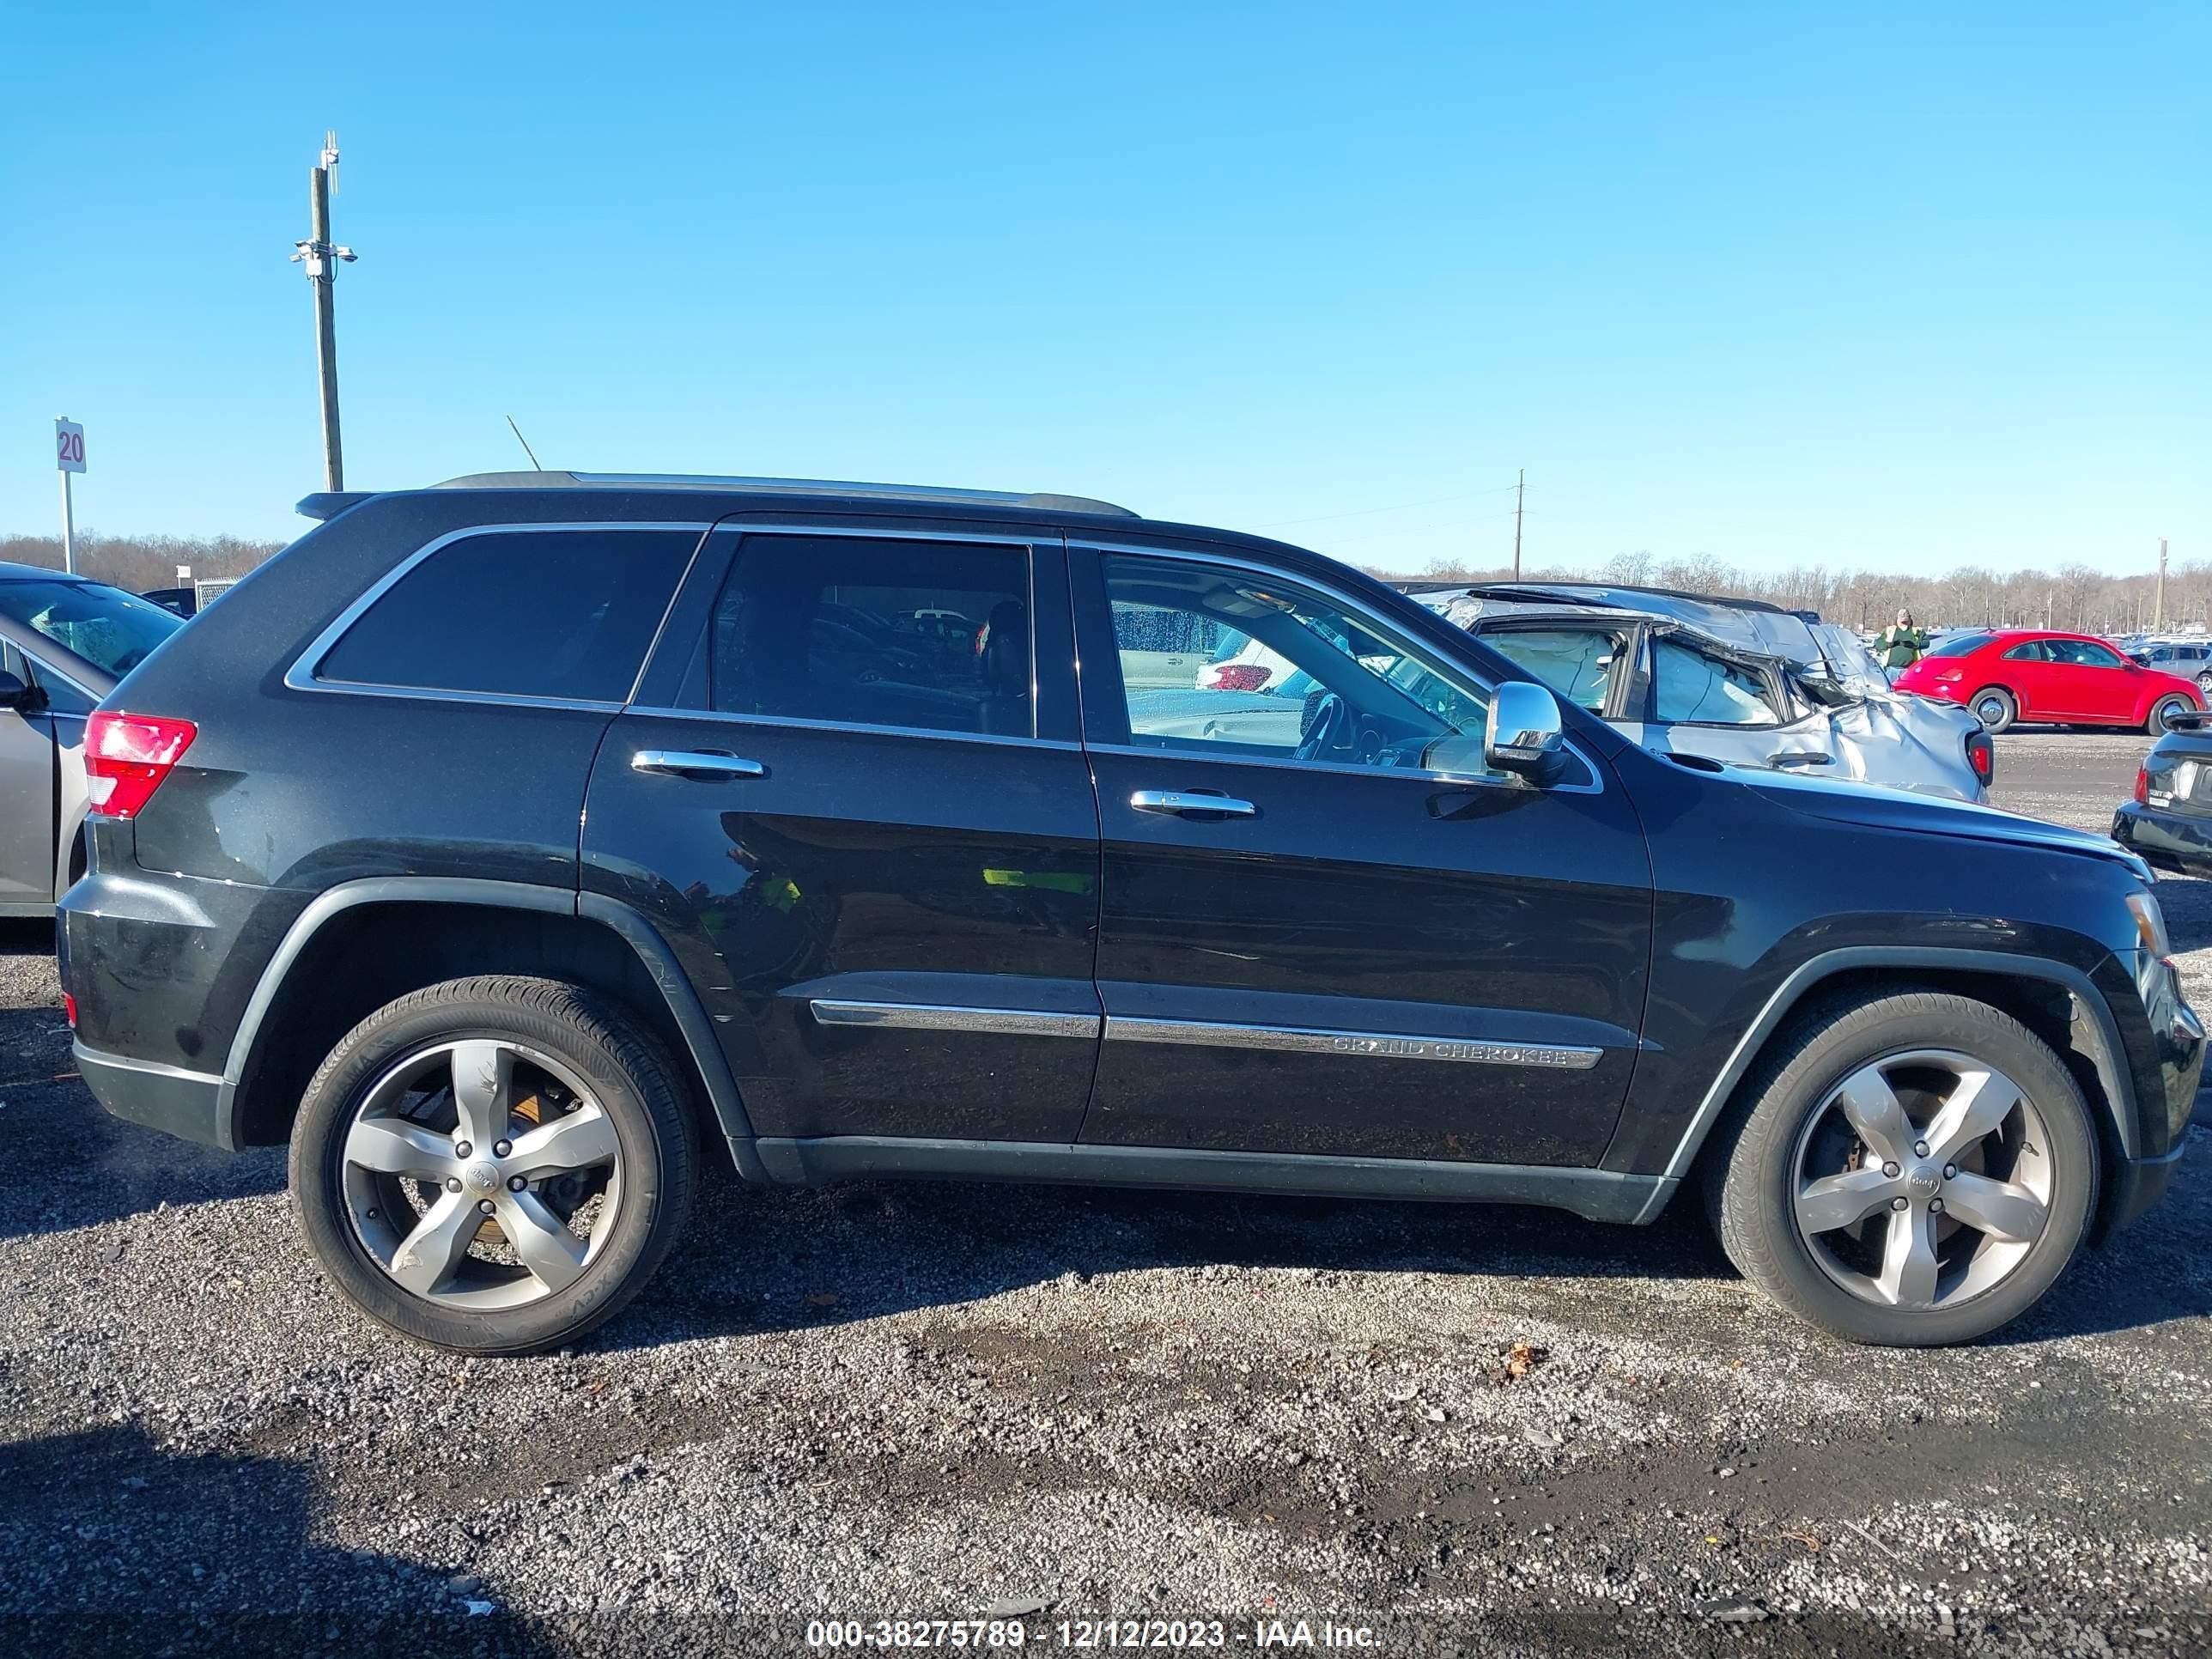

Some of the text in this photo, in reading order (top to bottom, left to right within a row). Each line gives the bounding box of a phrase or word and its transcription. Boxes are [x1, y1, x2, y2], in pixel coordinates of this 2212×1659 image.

[59, 431, 83, 463] 20
[1332, 1036, 1567, 1066] GRAND CHEROKEE
